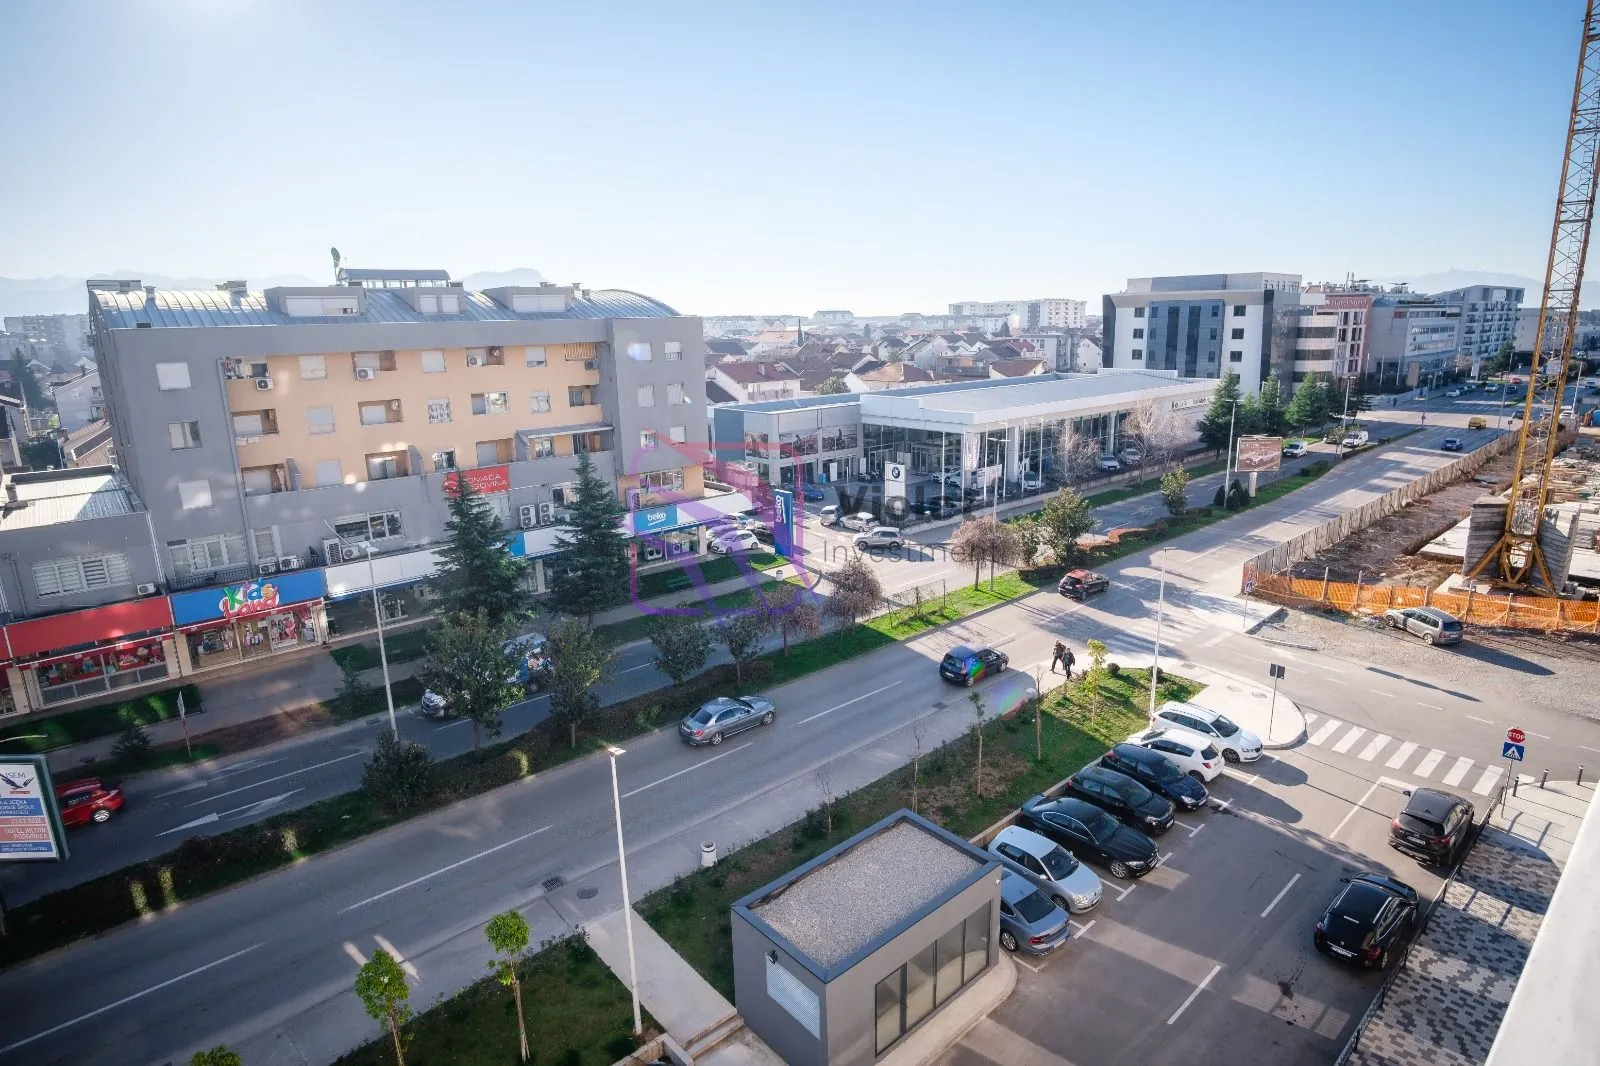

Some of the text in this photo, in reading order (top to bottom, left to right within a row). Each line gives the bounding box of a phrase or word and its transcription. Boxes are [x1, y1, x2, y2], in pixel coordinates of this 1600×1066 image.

[647, 512, 666, 521] beko
[223, 577, 275, 610] Kids
[1507, 731, 1525, 741] STOP
